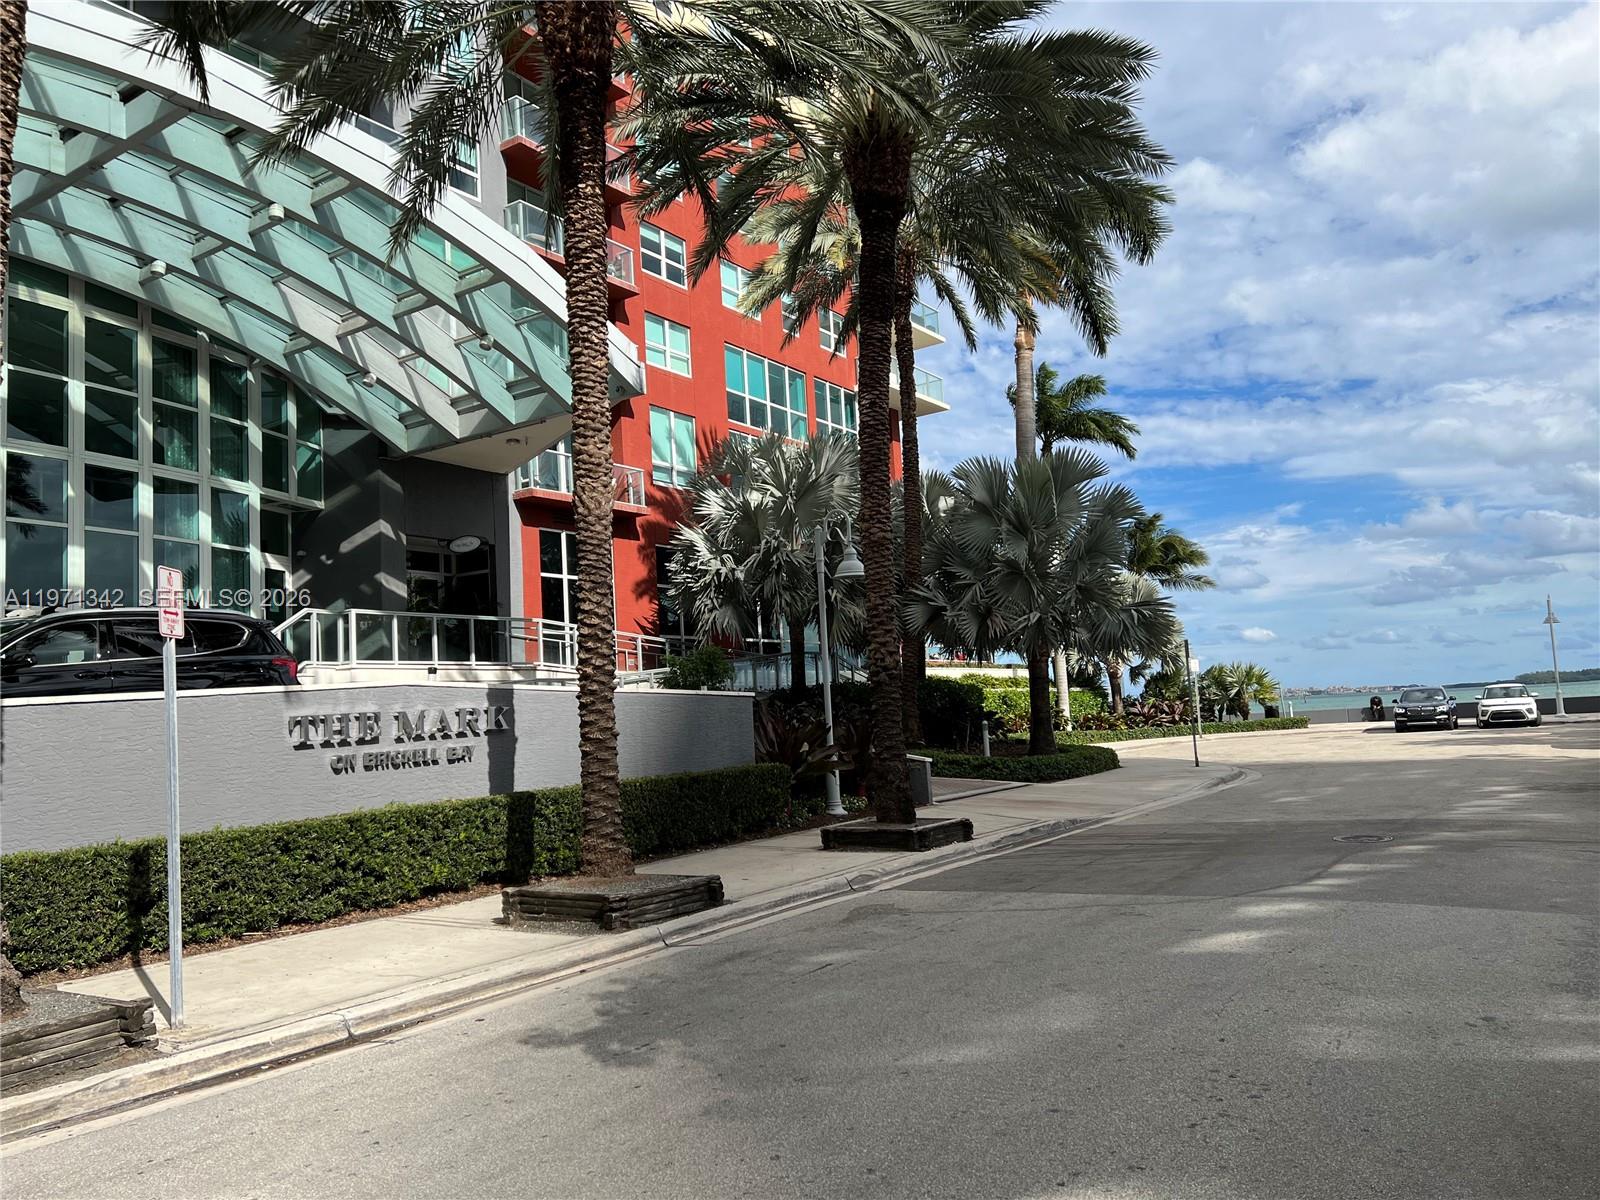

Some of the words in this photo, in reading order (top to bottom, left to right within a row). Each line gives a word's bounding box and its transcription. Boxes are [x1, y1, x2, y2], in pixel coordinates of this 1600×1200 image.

[288, 712, 382, 748] THE
[393, 706, 511, 743] MARK
[330, 754, 357, 774] ON
[363, 750, 440, 771] BRICKELL
[446, 746, 475, 764] BAY
